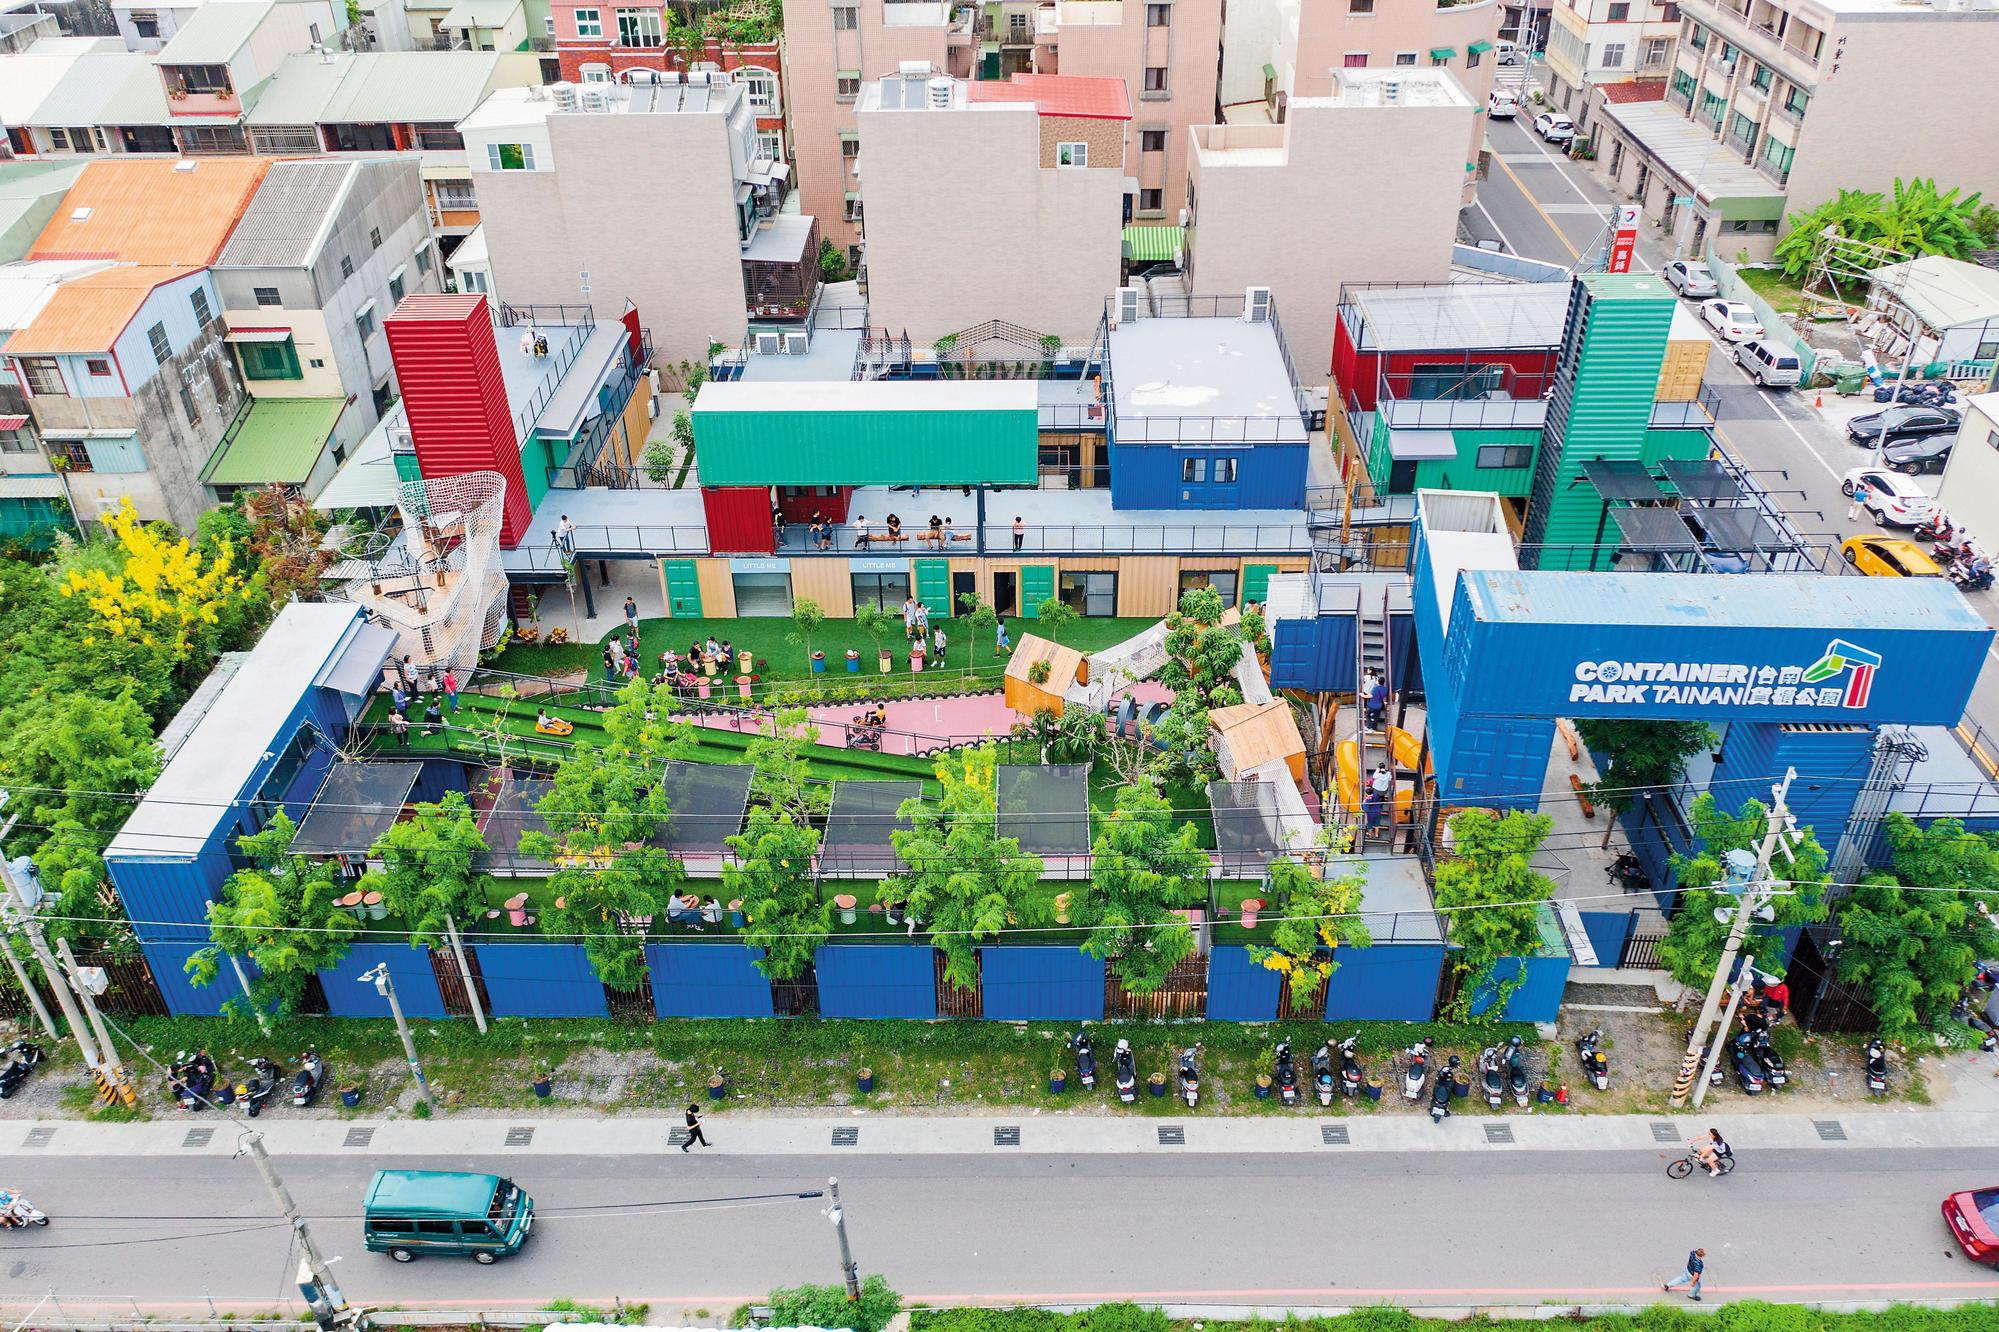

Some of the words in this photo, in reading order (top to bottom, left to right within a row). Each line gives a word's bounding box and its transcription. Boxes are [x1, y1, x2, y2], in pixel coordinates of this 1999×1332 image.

[1575, 660, 1749, 683] CONTAINER
[1758, 665, 1803, 684] 台南
[1569, 683, 1649, 703] PARK
[1652, 685, 1744, 705] TAINAN
[1748, 686, 1843, 706] 貨櫃公園
